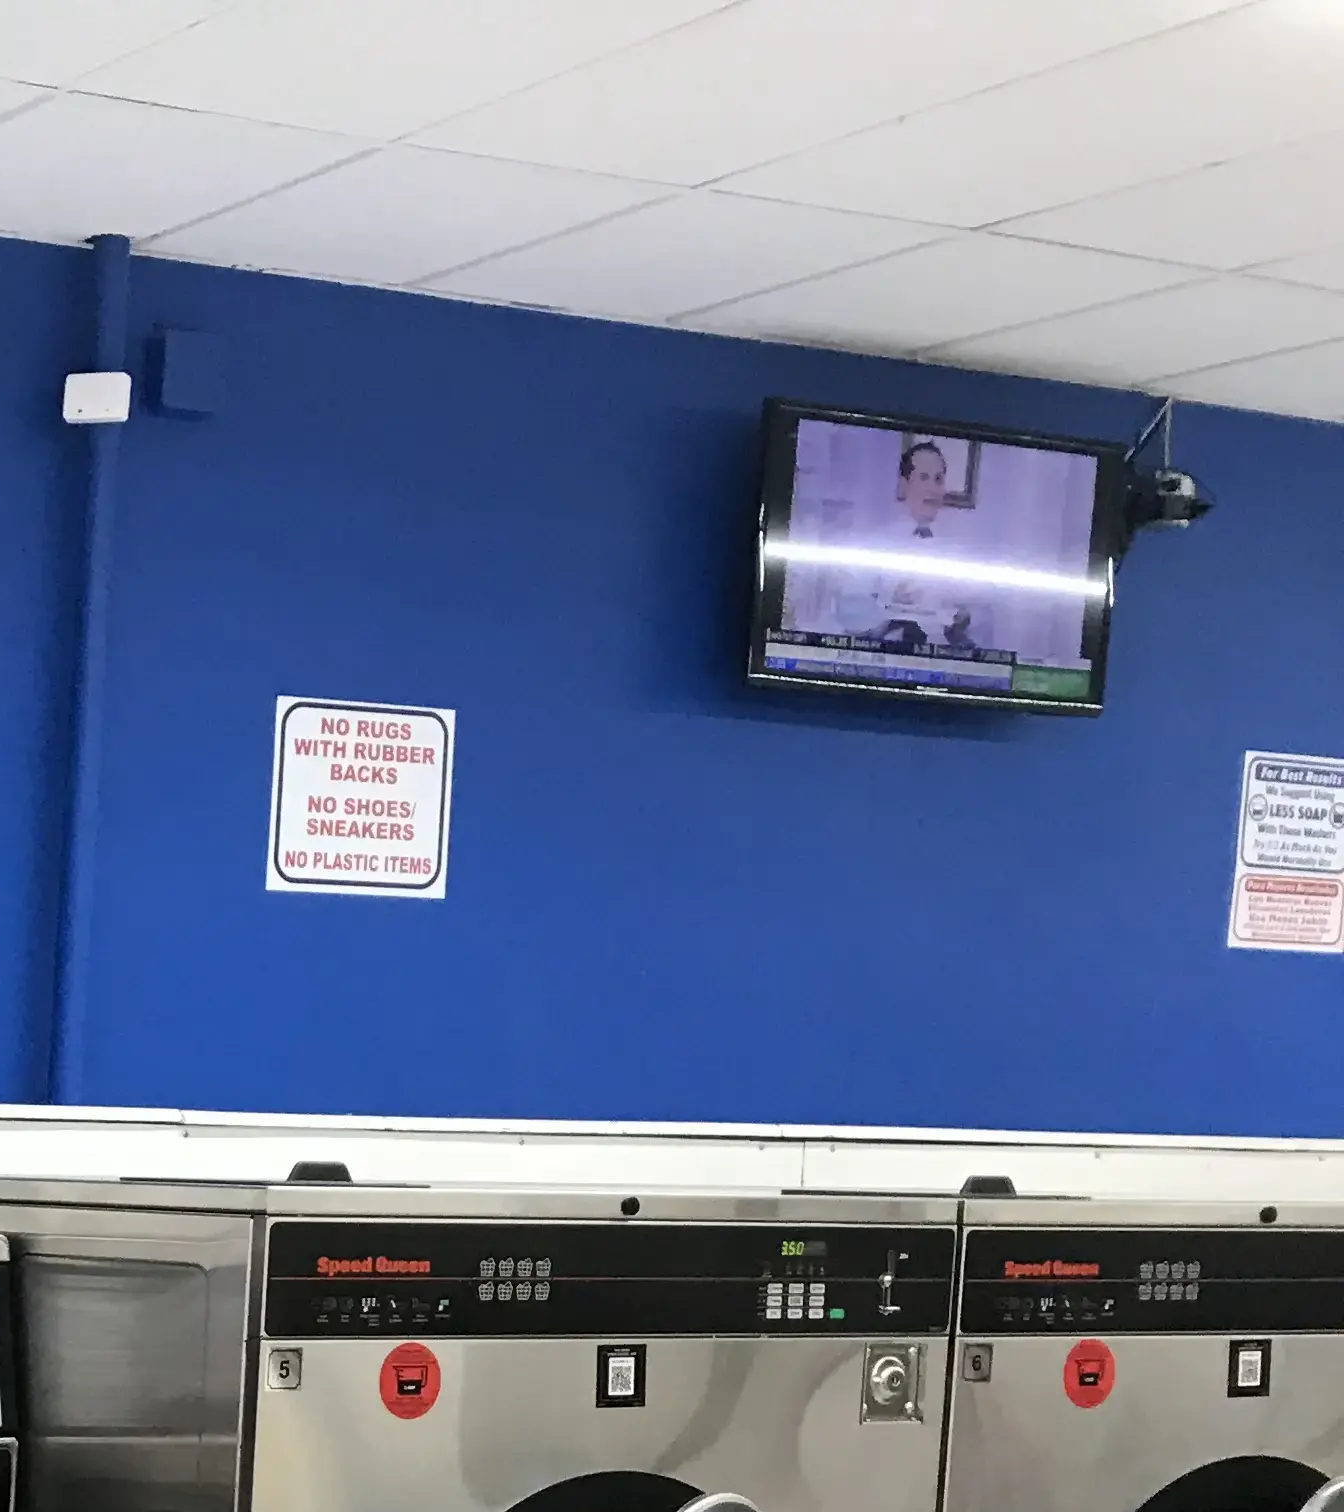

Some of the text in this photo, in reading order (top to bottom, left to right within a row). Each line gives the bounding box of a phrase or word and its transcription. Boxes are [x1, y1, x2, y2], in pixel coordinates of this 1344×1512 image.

[321, 717, 412, 740] NO RUGS
[294, 738, 436, 764] WITH RUBBER
[330, 764, 398, 785] BACKS
[308, 796, 336, 814] NO
[1270, 803, 1328, 821] LESS SOAP
[306, 818, 415, 840] SNEAKERS
[285, 851, 432, 875] NO PLASTIC ITEMS
[317, 1255, 430, 1276] Speed Queen
[279, 1360, 290, 1379] 5
[972, 1354, 982, 1372] 6
